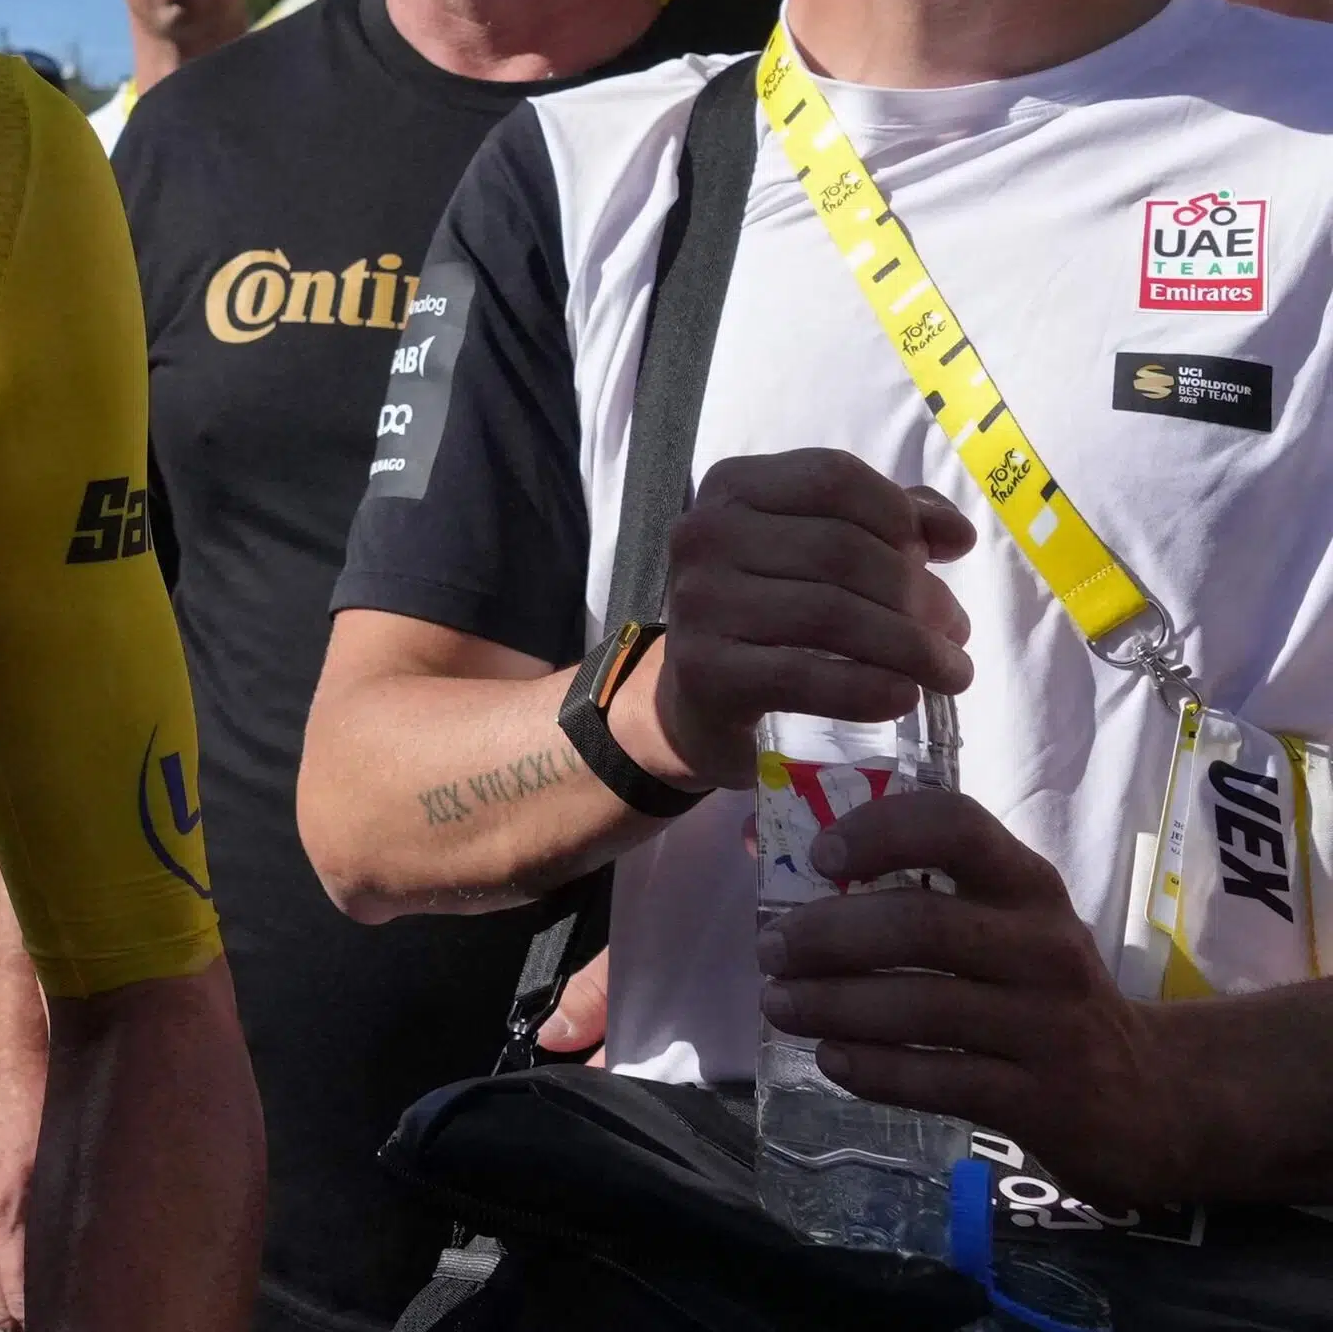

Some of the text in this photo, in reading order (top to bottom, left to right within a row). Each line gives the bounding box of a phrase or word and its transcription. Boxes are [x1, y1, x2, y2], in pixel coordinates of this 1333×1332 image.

[1154, 228, 1254, 258] UAE
[1154, 260, 1254, 275] TEAM
[1149, 282, 1253, 302] Emirates
[409, 293, 447, 316] nalog
[1178, 366, 1203, 378] UCI
[1178, 376, 1252, 396] WORLDTOUR
[1178, 386, 1239, 404] BEST TEAM
